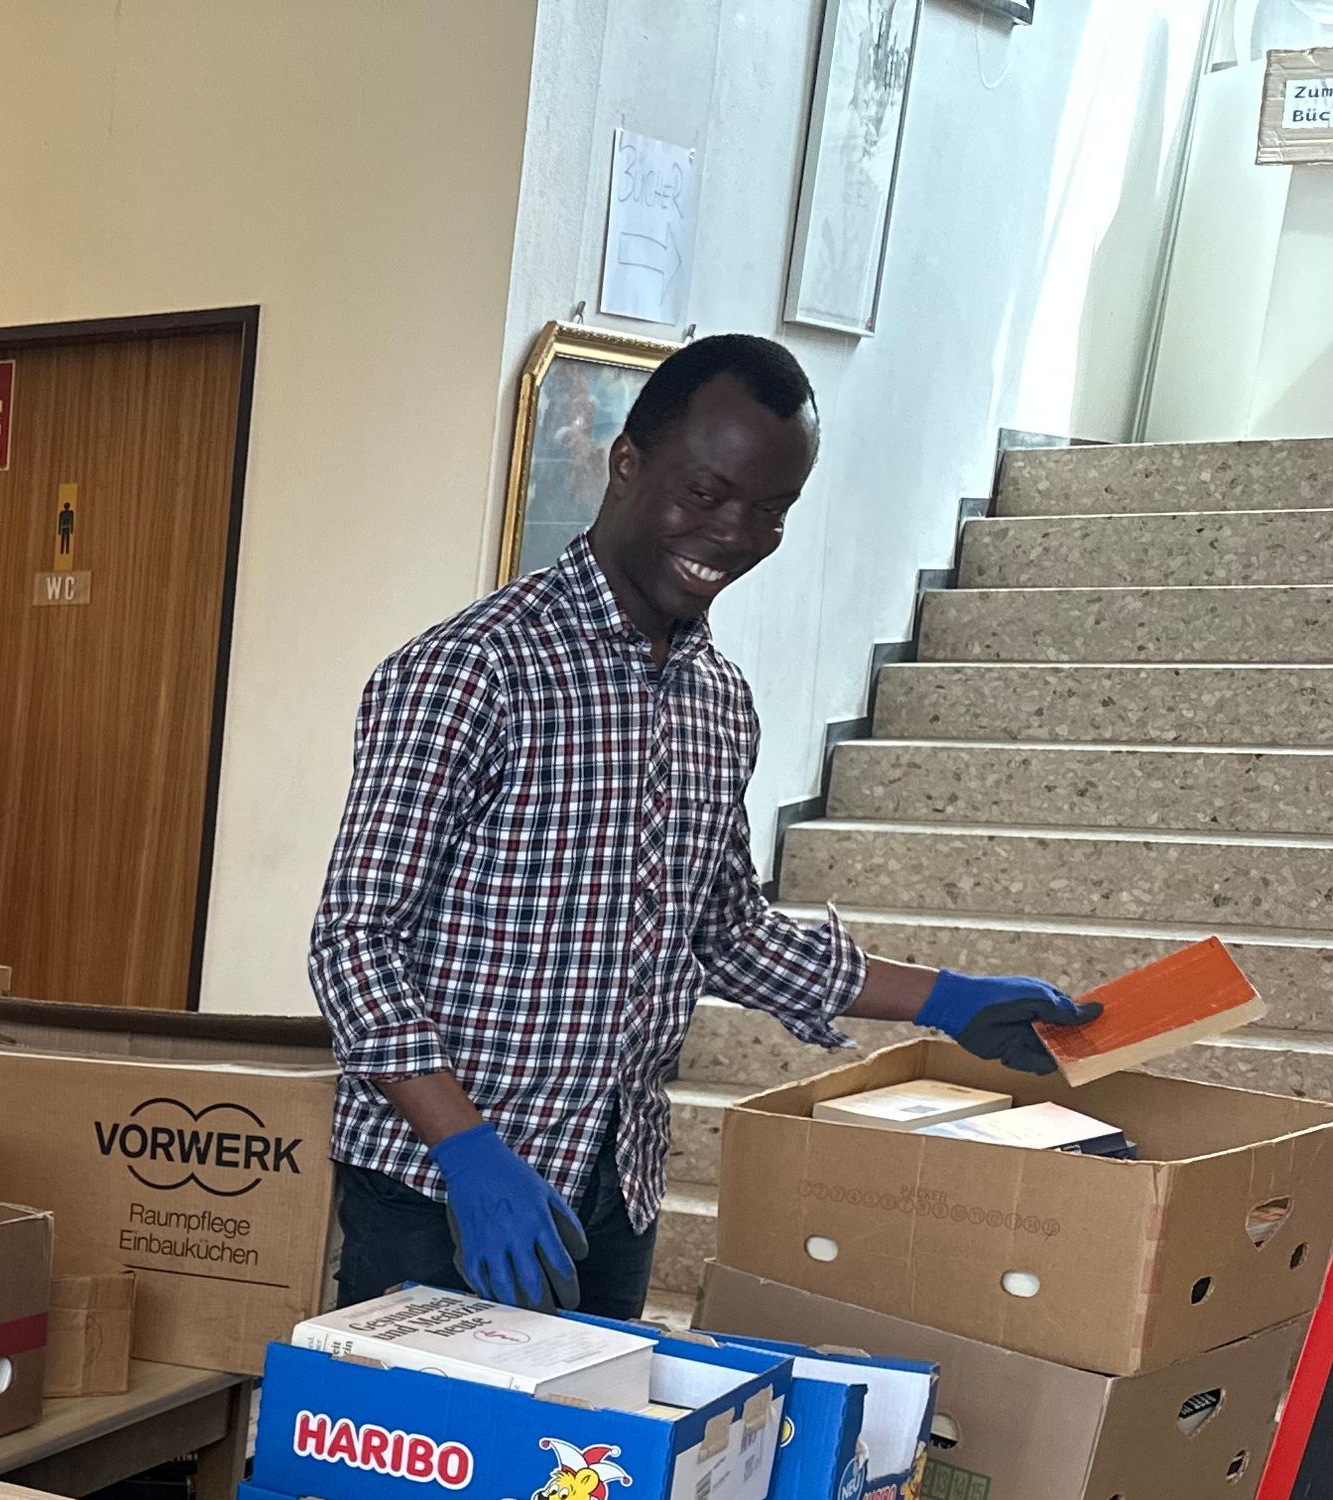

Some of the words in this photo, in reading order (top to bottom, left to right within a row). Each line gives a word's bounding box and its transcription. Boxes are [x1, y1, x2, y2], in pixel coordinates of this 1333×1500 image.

[1294, 86, 1333, 99] Zum
[46, 576, 75, 600] WC
[94, 1121, 303, 1174] VORWERK
[130, 1202, 251, 1241] Raumpflege
[118, 1228, 259, 1267] Einbauküchen
[349, 1296, 463, 1332] Gesundheit
[373, 1322, 417, 1341] und
[424, 1317, 493, 1338] heute
[295, 1411, 472, 1488] HARIBO
